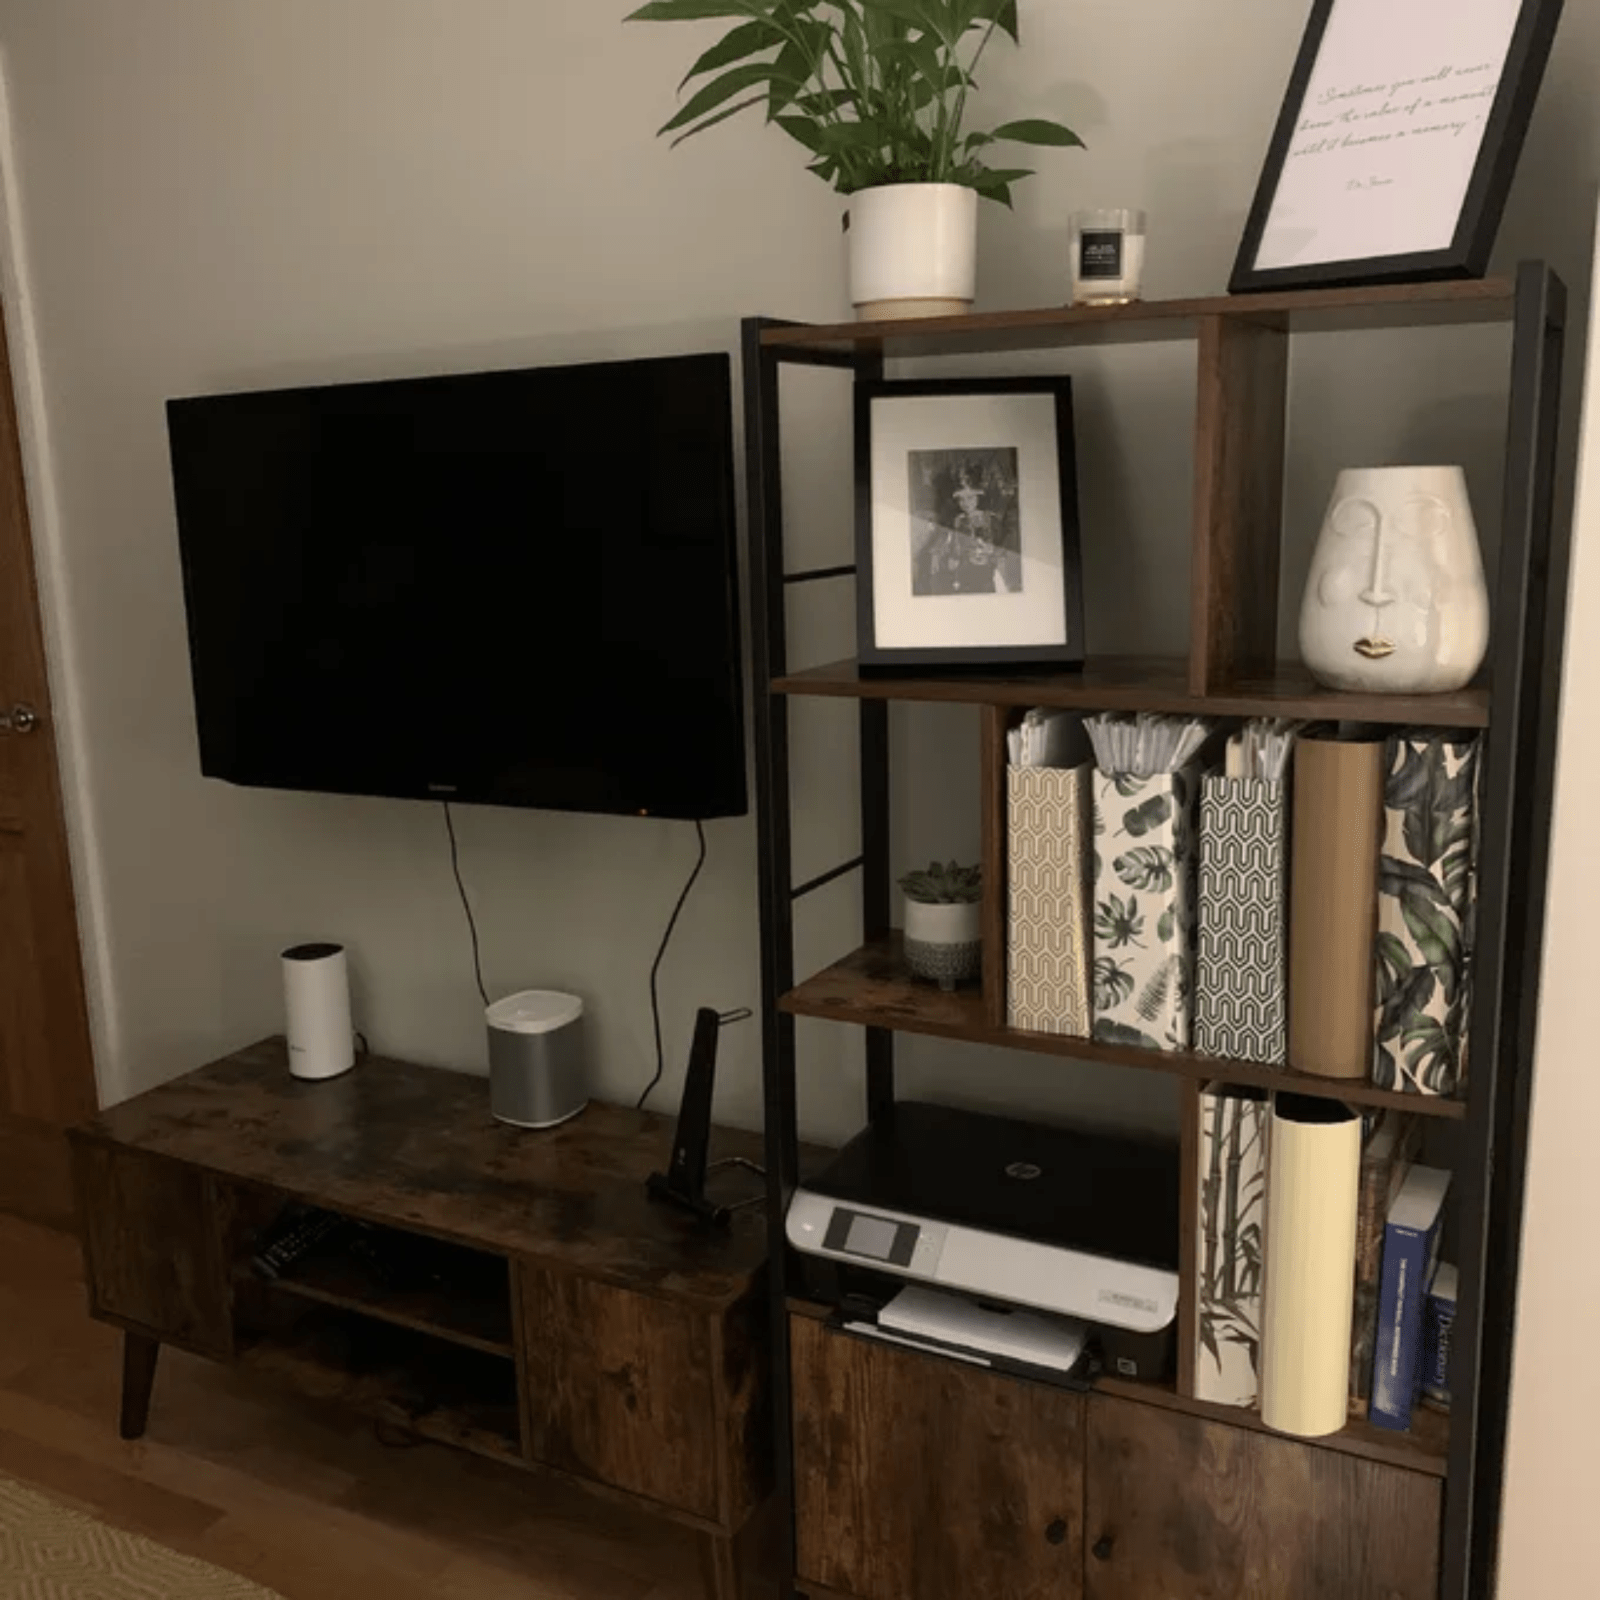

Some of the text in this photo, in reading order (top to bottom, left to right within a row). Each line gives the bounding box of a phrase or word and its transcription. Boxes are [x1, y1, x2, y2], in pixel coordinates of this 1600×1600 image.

[1387, 78, 1416, 97] you
[1421, 65, 1453, 83] will
[1404, 96, 1422, 116] of
